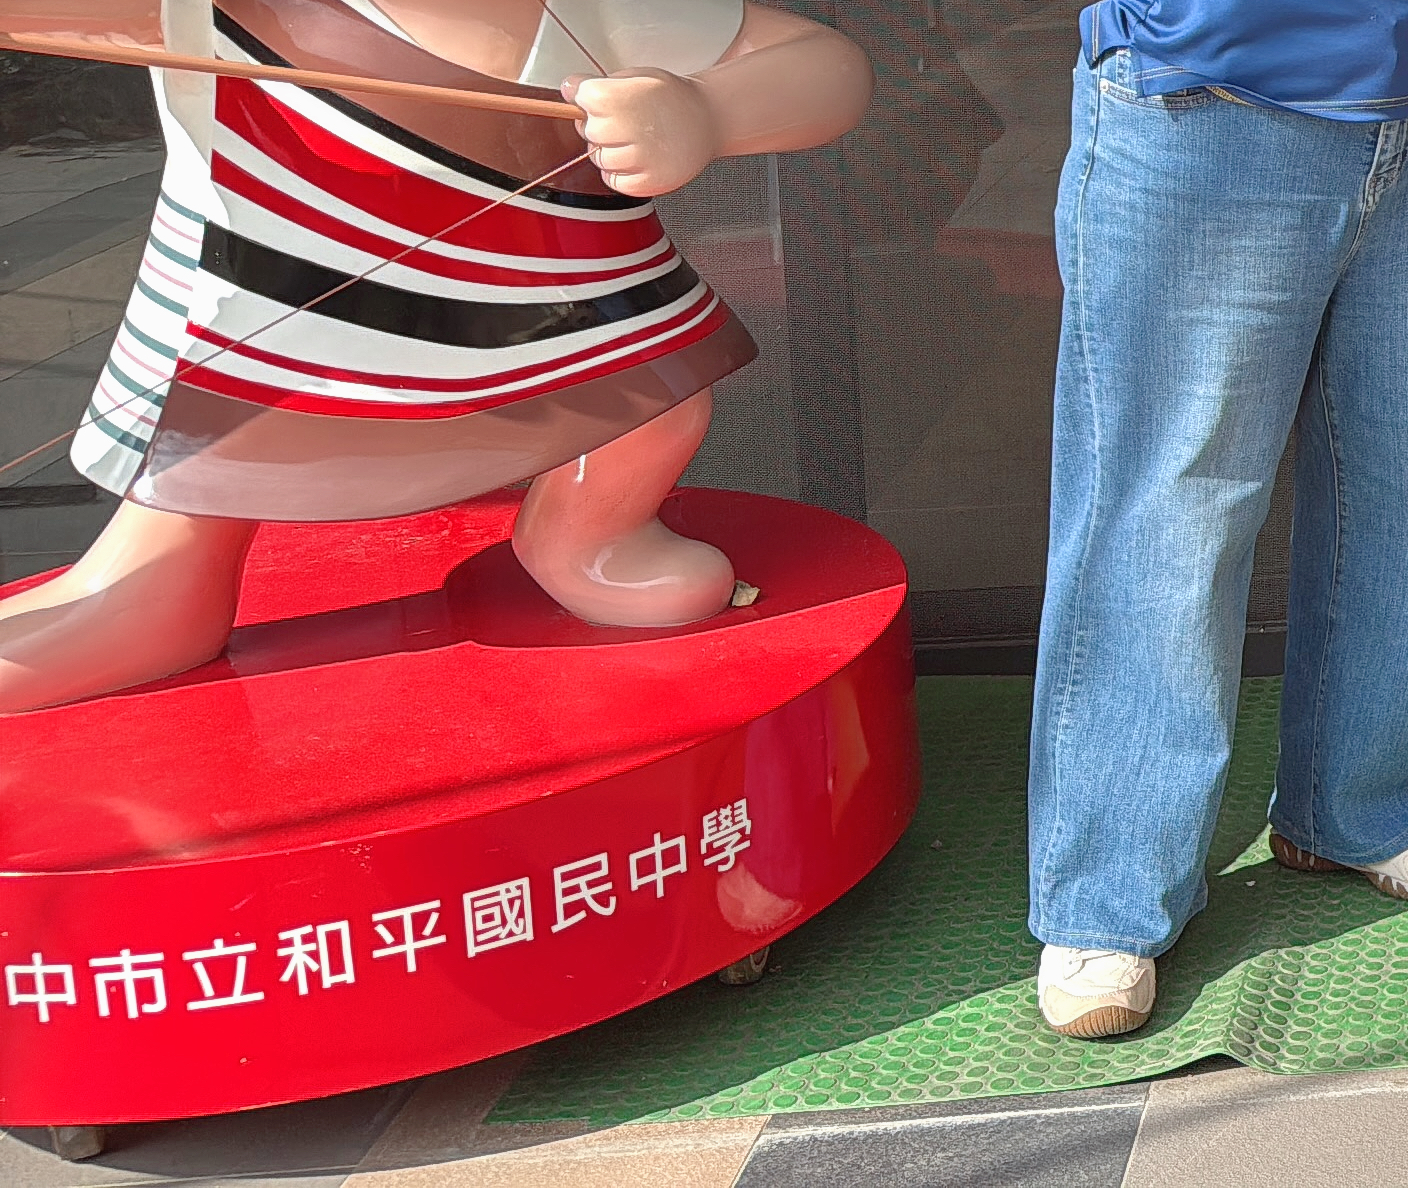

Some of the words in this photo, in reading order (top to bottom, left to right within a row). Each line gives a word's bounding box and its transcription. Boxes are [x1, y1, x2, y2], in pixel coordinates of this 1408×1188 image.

[4, 797, 753, 1023] 中市立和平國民中學
